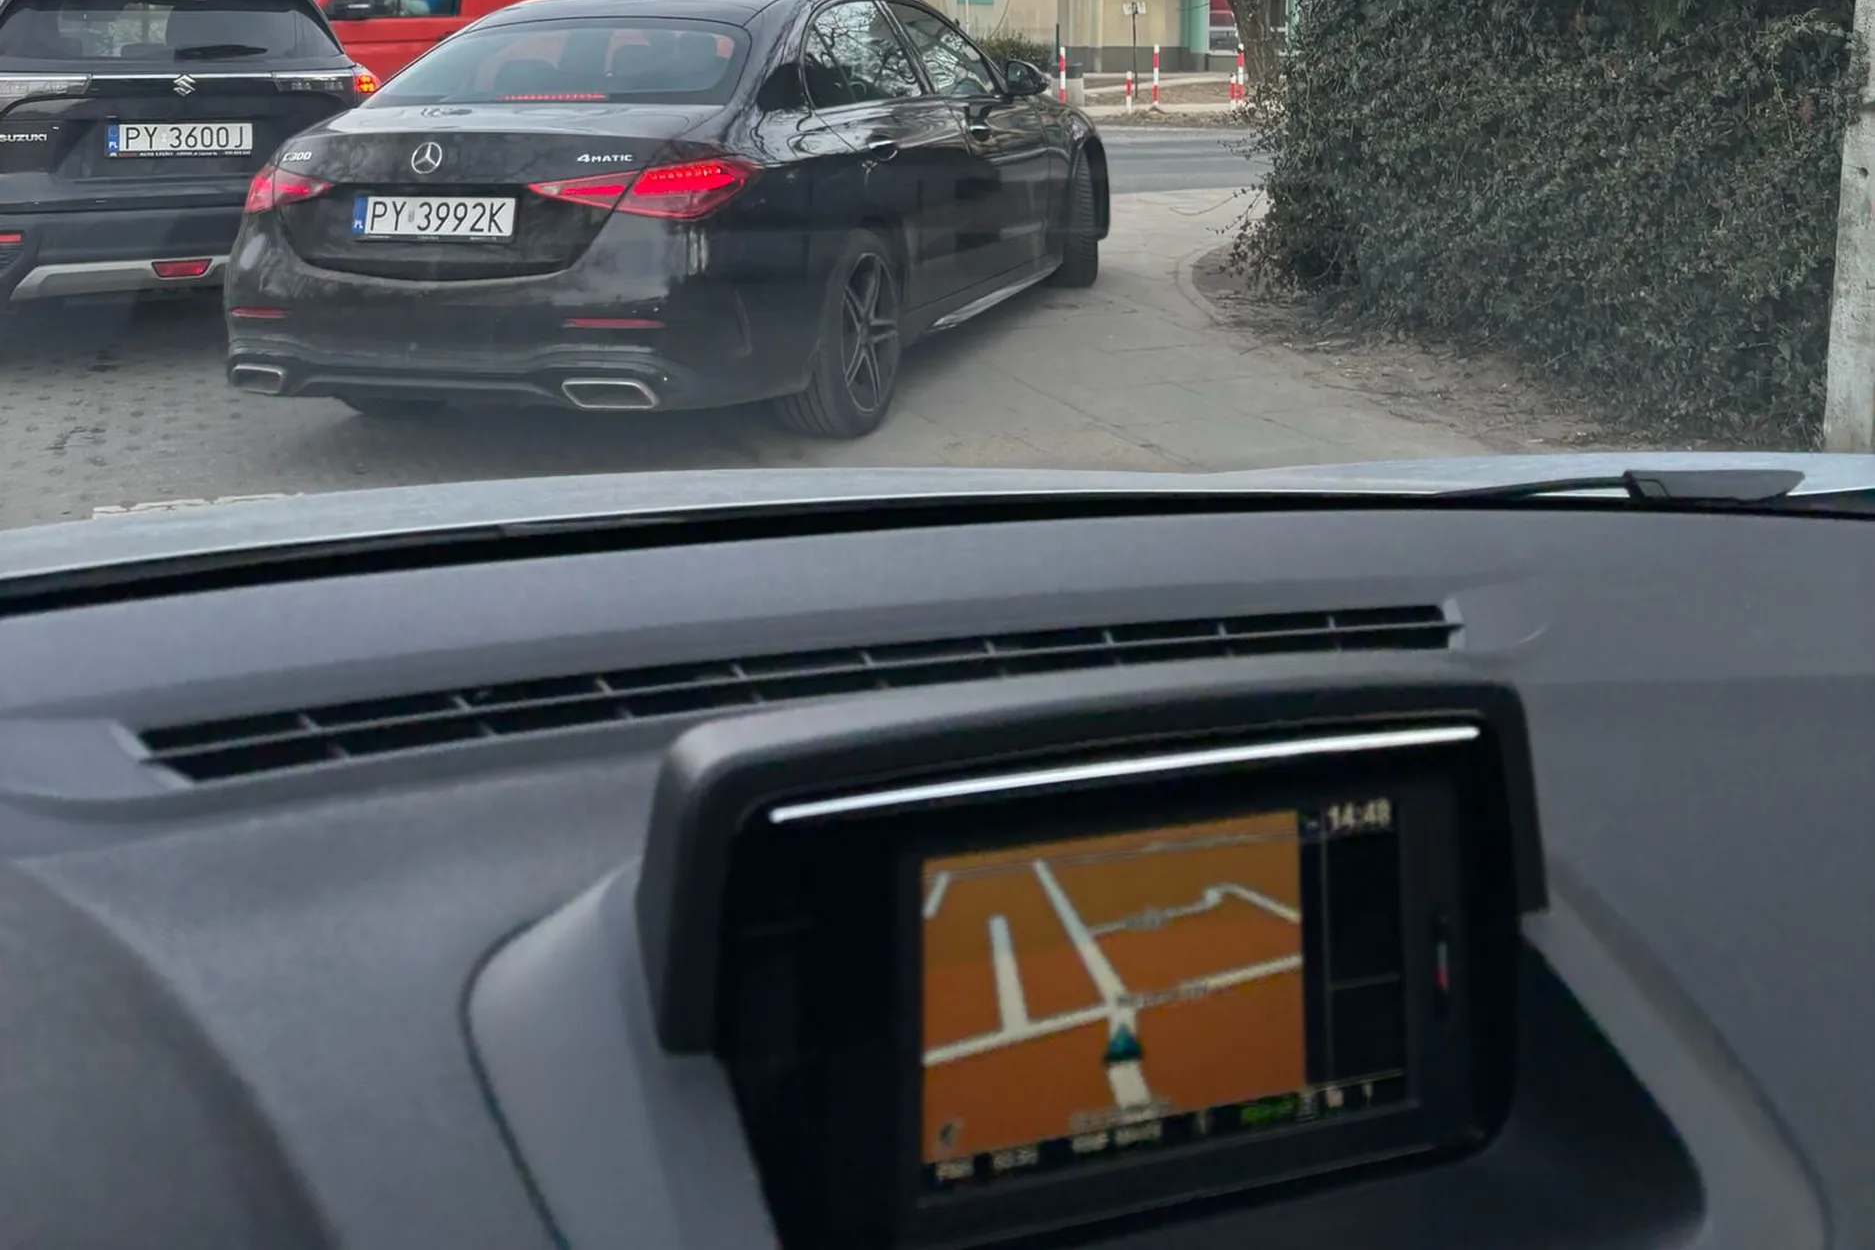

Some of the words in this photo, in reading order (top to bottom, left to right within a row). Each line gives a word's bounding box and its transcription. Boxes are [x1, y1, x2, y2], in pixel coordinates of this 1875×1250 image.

[0, 133, 47, 142] SUZUKI
[125, 126, 158, 150] PY
[169, 126, 243, 149] 3600J
[577, 153, 633, 163] 4MATIC
[370, 201, 407, 231] PY
[417, 202, 506, 234] 3992K
